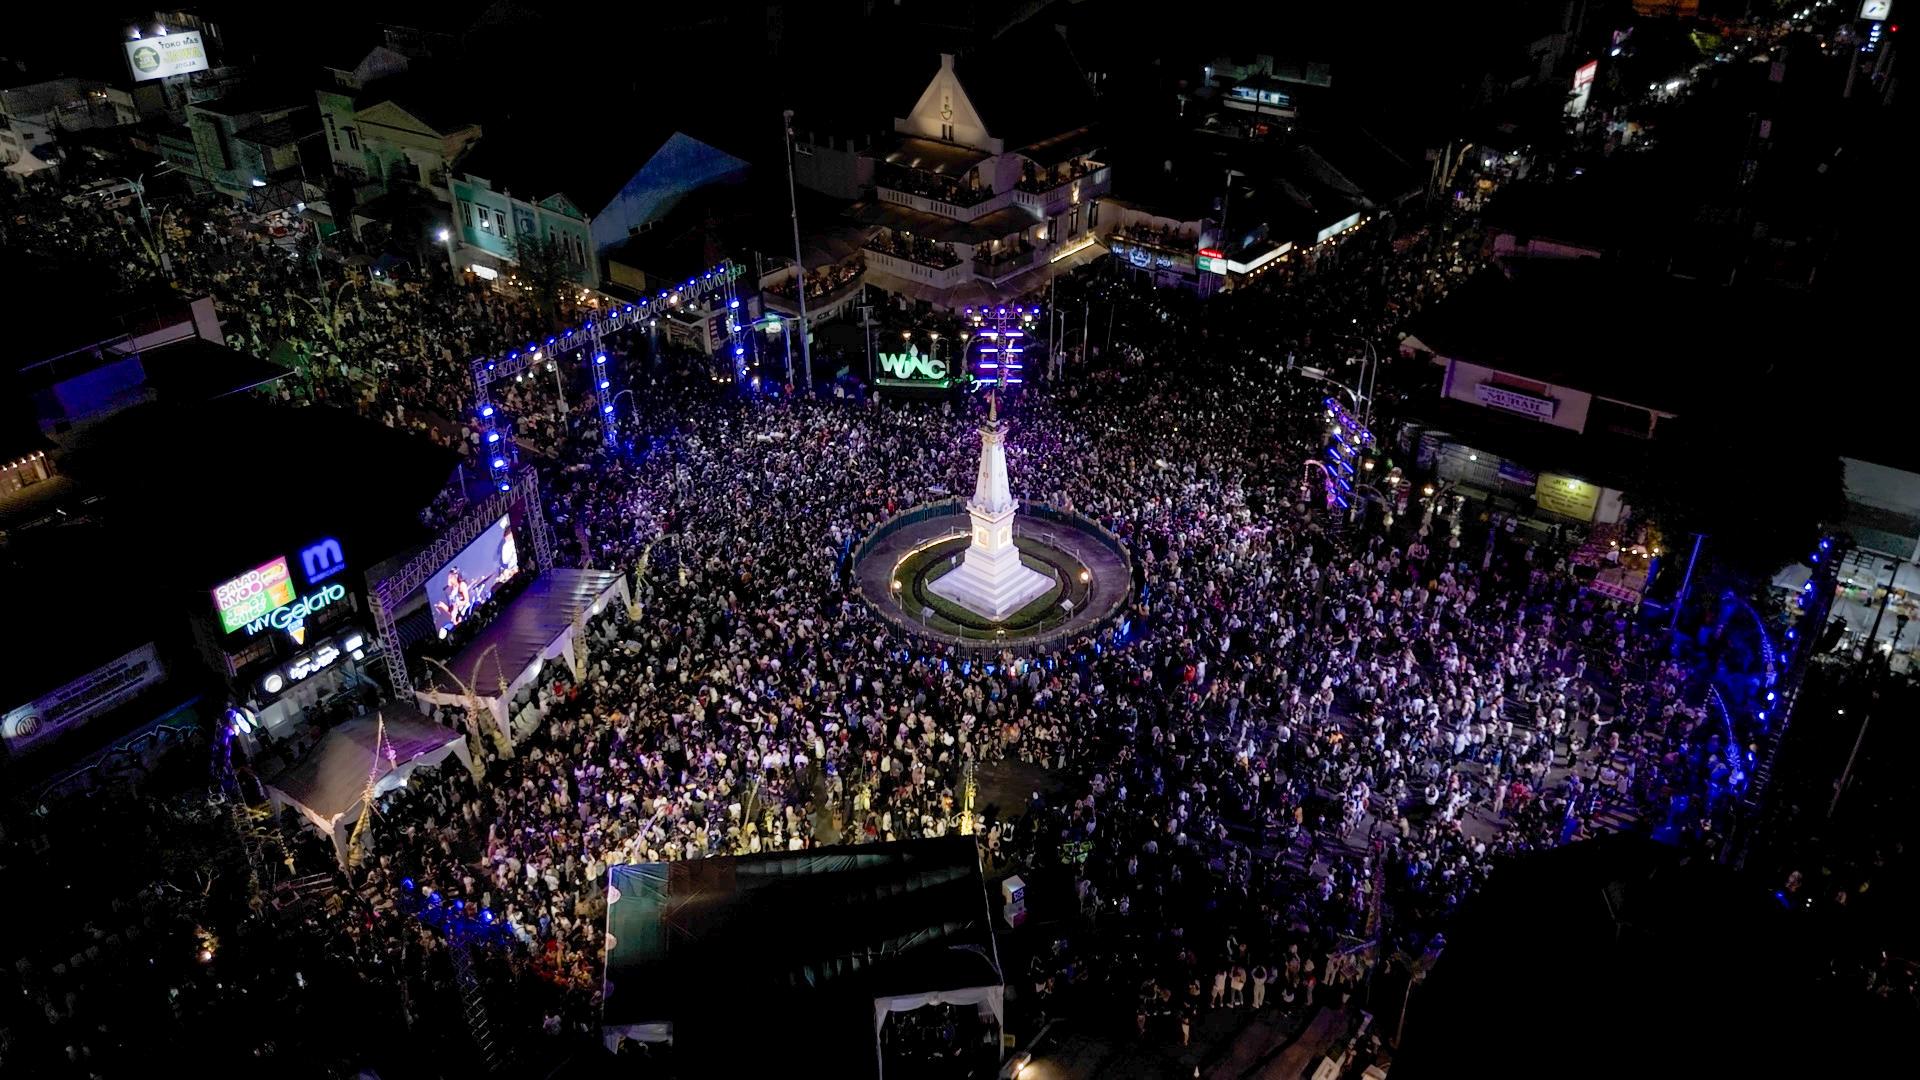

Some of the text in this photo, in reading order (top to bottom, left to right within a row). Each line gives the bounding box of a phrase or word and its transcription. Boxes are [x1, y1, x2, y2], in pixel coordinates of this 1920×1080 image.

[183, 38, 199, 46] MAS
[217, 571, 259, 599] SALAD
[270, 584, 345, 629] Gelato
